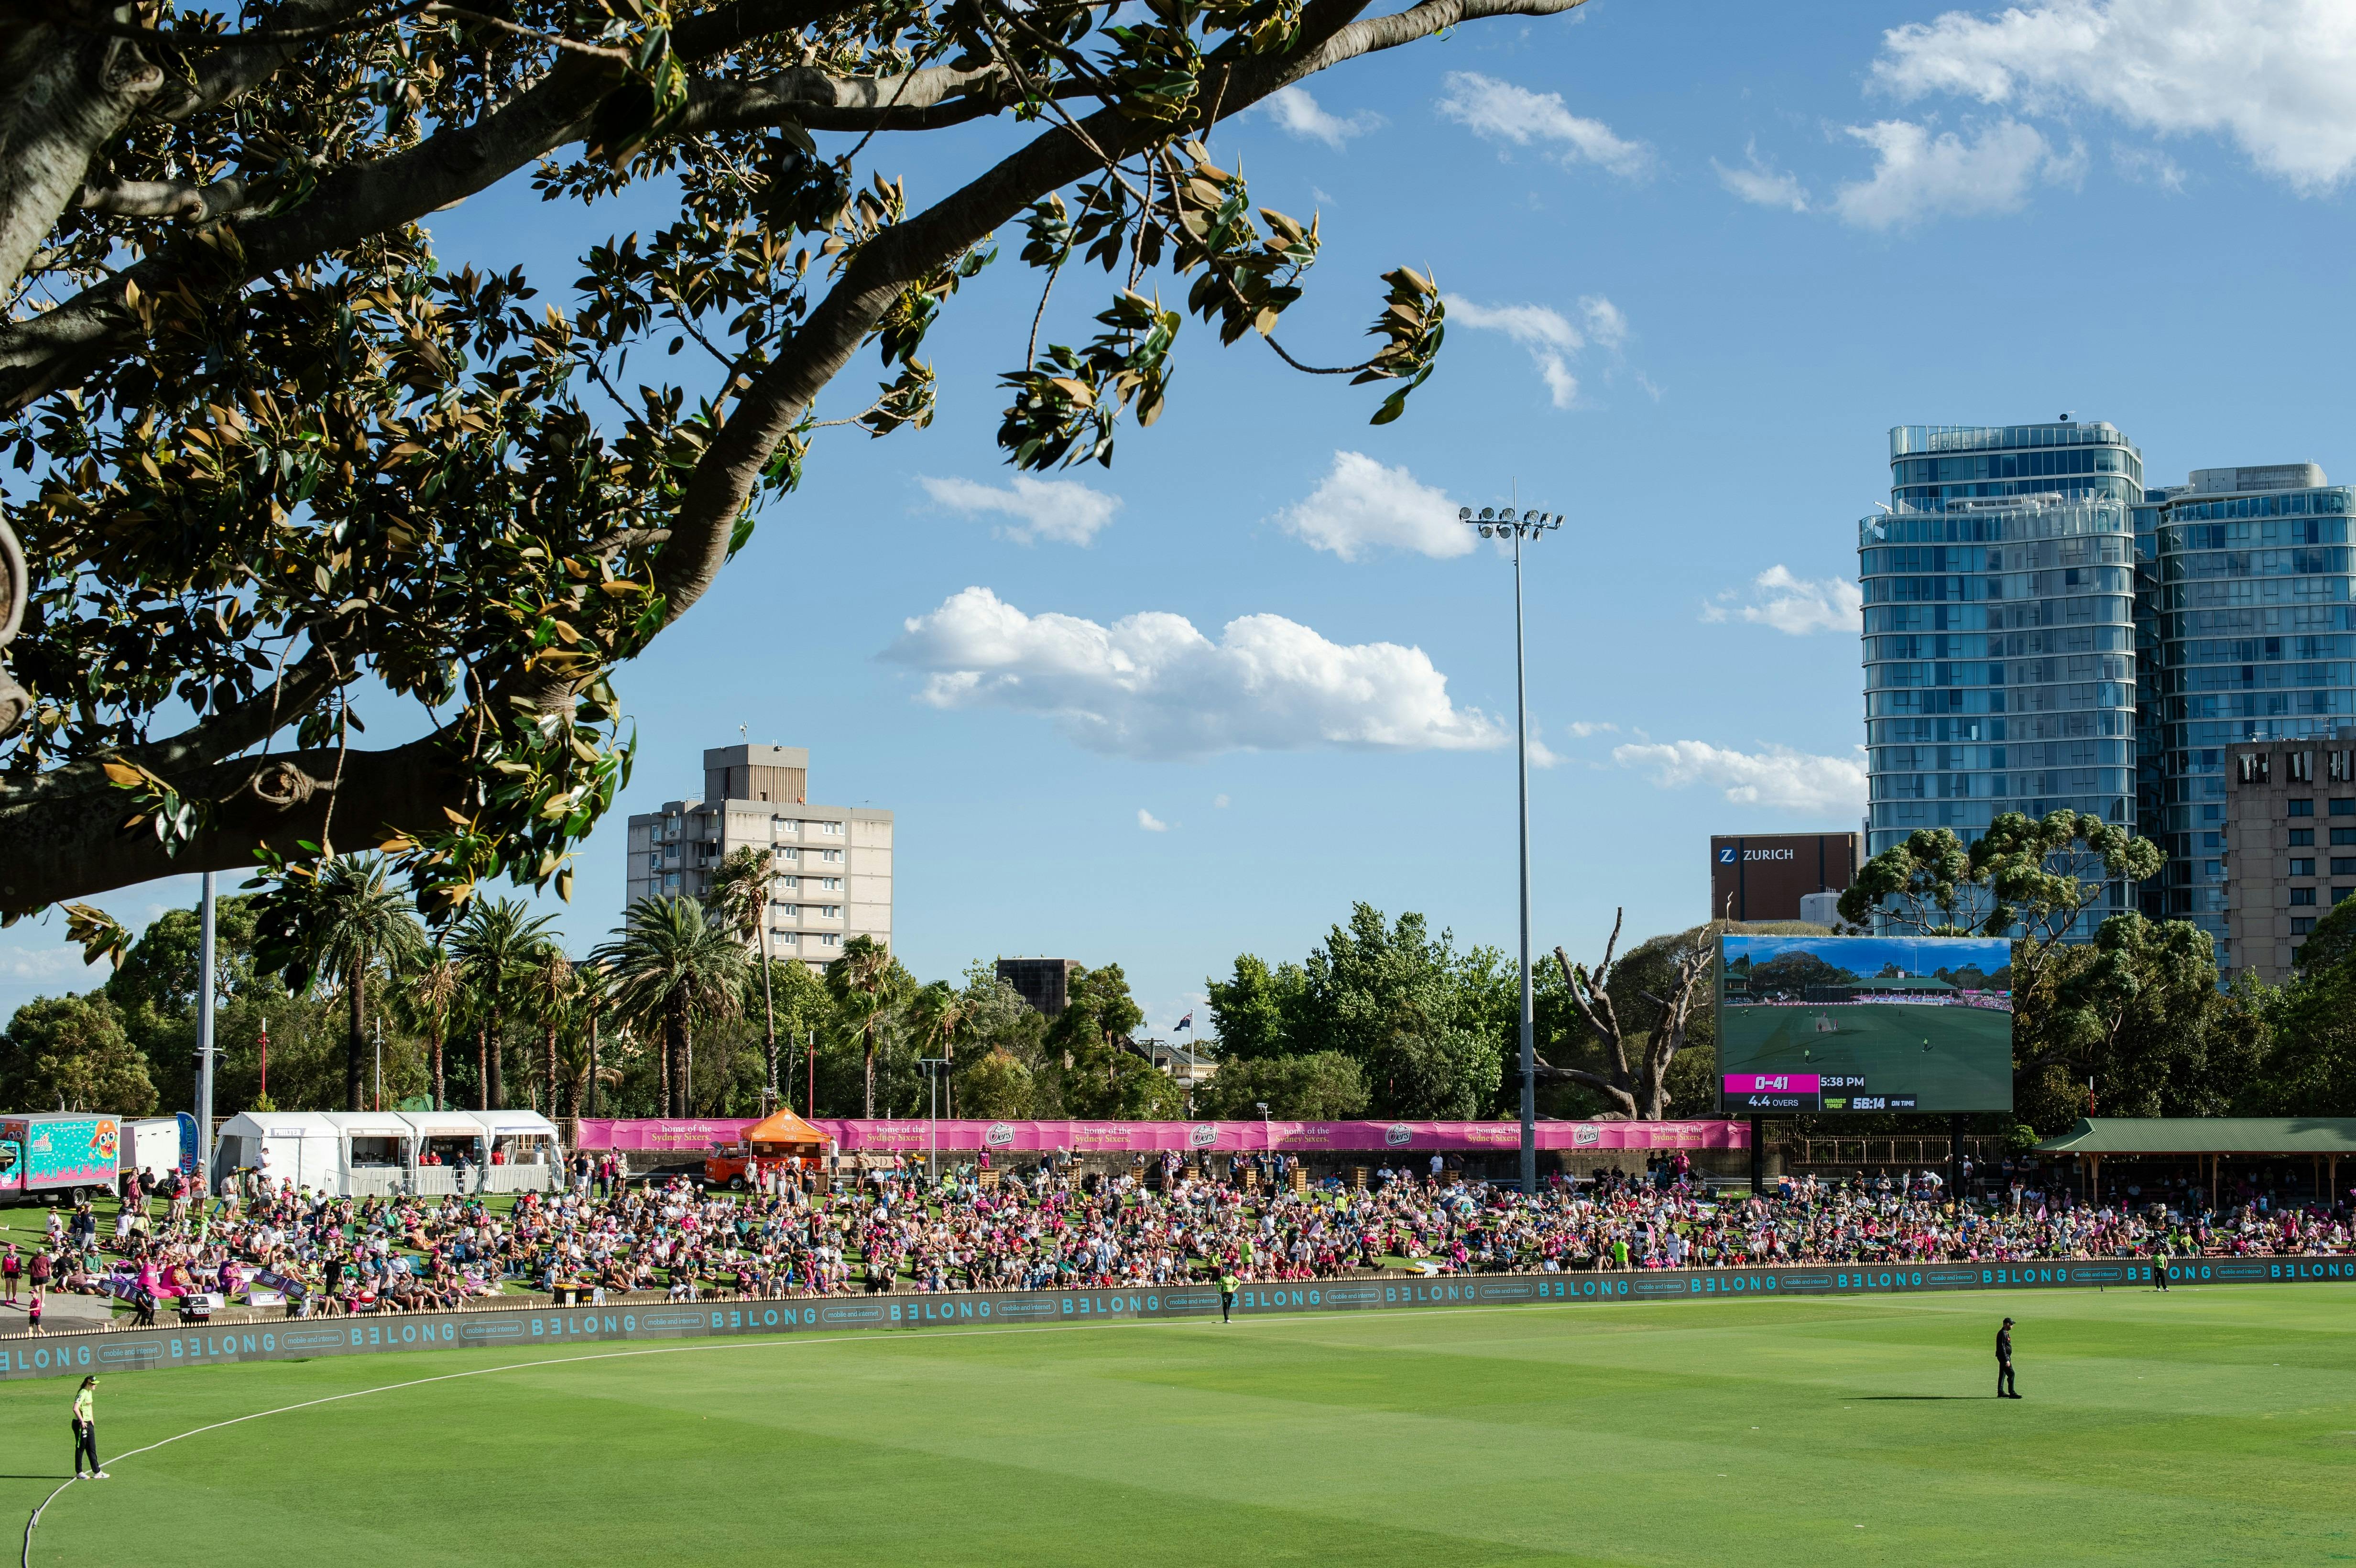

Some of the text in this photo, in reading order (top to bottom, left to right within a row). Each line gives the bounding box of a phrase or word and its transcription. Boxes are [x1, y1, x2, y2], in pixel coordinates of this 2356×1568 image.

[1743, 849, 1793, 860] ZURICH
[1755, 1076, 1789, 1090] 0-41
[1821, 1077, 1865, 1087] 5:38 PM
[1748, 1095, 1770, 1106] 4.4
[1853, 1098, 1885, 1109] 56:14
[662, 1124, 712, 1132] home of the
[876, 1125, 925, 1133] home of the
[1108, 1126, 1116, 1134] of
[652, 1132, 711, 1143] Sydney Sixers.
[867, 1133, 925, 1143] Sydney Sixers.
[1075, 1134, 1131, 1144] Sydney Sixers.
[1276, 1135, 1302, 1144] Sydney
[1468, 1134, 1494, 1143] Sydney
[1653, 1133, 1677, 1143] Sydney
[850, 1157, 888, 1166] SND
[2127, 1265, 2211, 1281] BEONG
[263, 1274, 276, 1285] weber
[288, 1336, 307, 1344] mobile
[103, 1349, 123, 1357] mobile
[124, 1347, 136, 1356] and
[0, 1346, 89, 1371] ELONG
